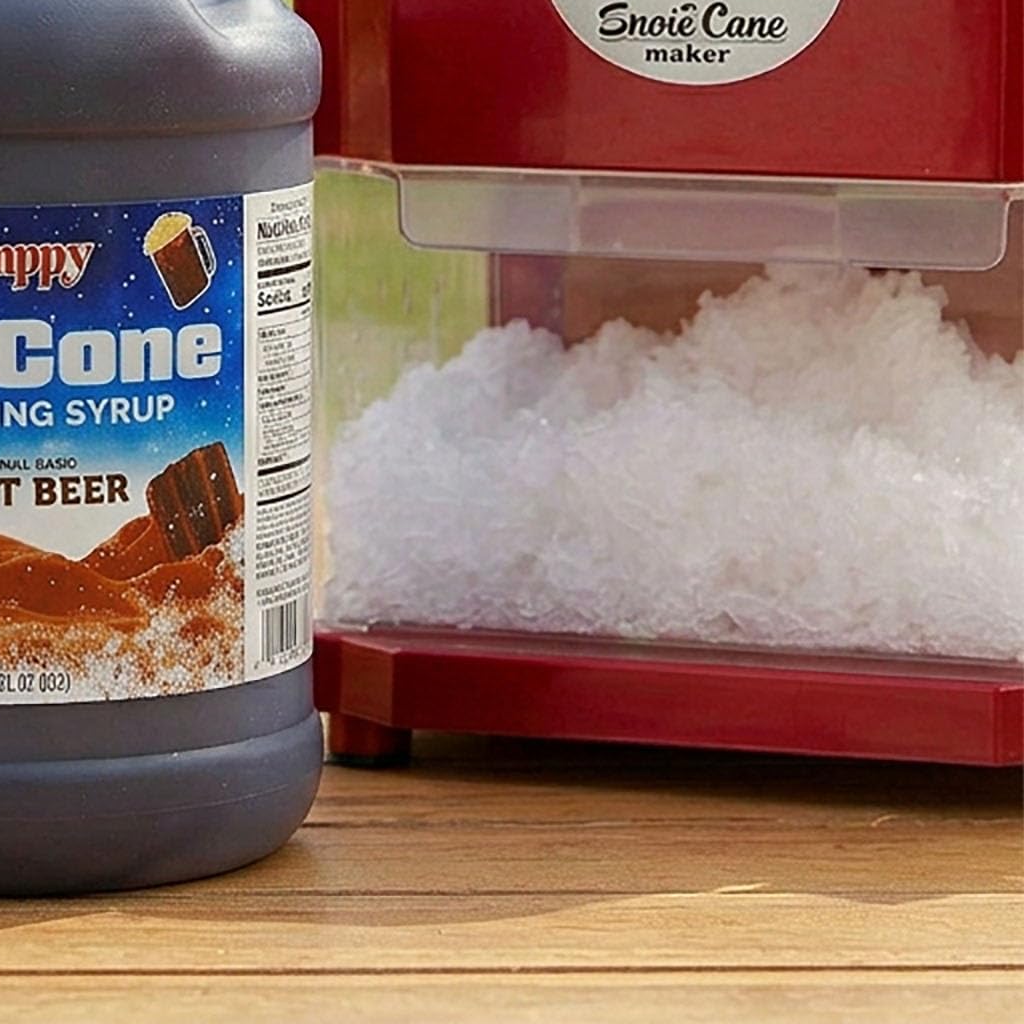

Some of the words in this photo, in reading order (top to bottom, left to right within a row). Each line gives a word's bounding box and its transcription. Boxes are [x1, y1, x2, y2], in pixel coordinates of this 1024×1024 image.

[701, 1, 788, 39] Cane
[645, 44, 731, 63] maker
[65, 394, 175, 425] SYRUP
[32, 473, 130, 506] BEER
